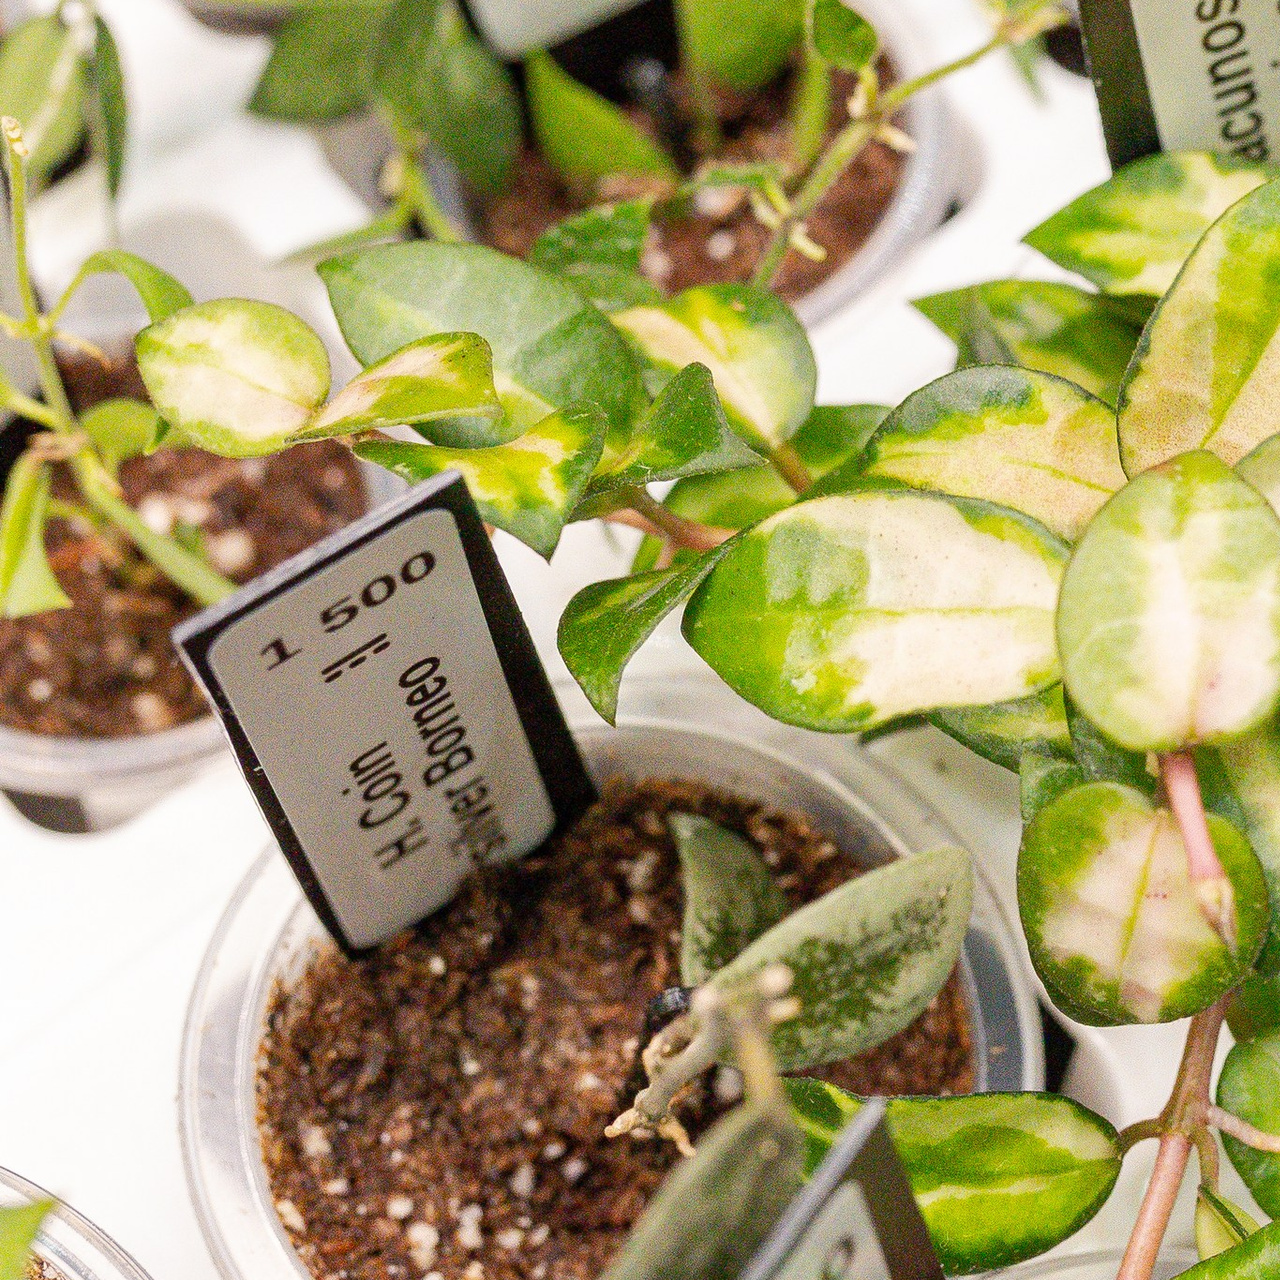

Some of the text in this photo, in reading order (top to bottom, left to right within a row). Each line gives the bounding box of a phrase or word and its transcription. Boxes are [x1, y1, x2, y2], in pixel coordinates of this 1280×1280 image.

[259, 550, 438, 670] 1 500
[398, 655, 474, 789] Borneo
[342, 740, 429, 870] H. Coin
